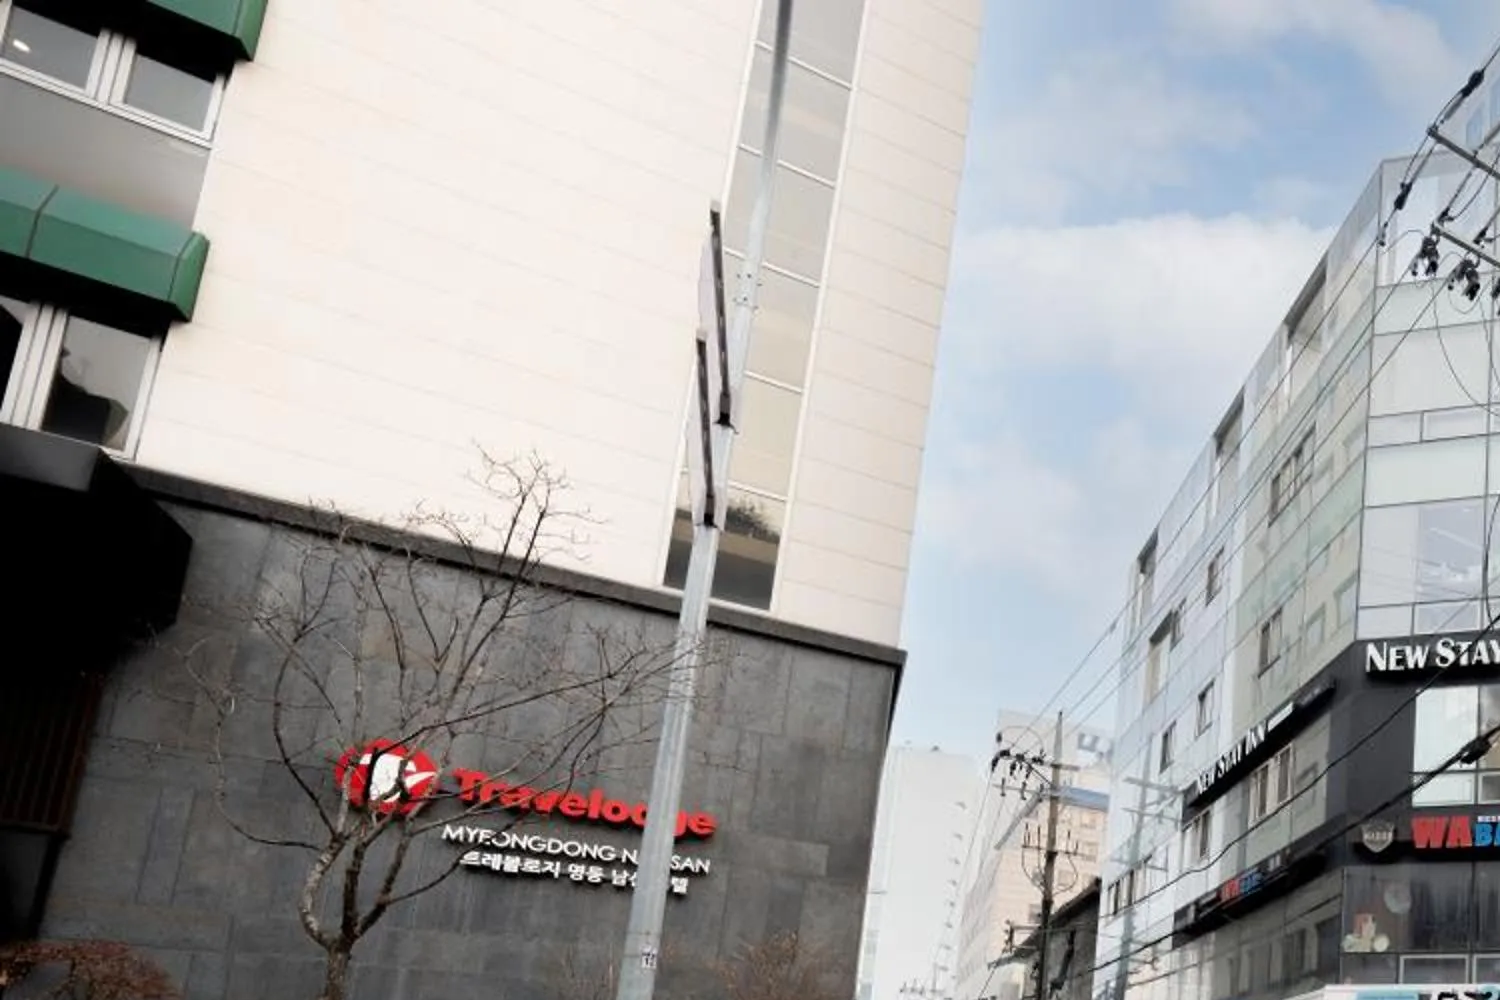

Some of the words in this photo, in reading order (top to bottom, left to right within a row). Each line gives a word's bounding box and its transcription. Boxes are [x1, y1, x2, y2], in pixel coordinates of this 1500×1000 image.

[1365, 640, 1430, 673] NEW
[441, 824, 616, 861] MYEONGDONG
[621, 848, 711, 875] NSAN
[568, 863, 604, 883] 명동
